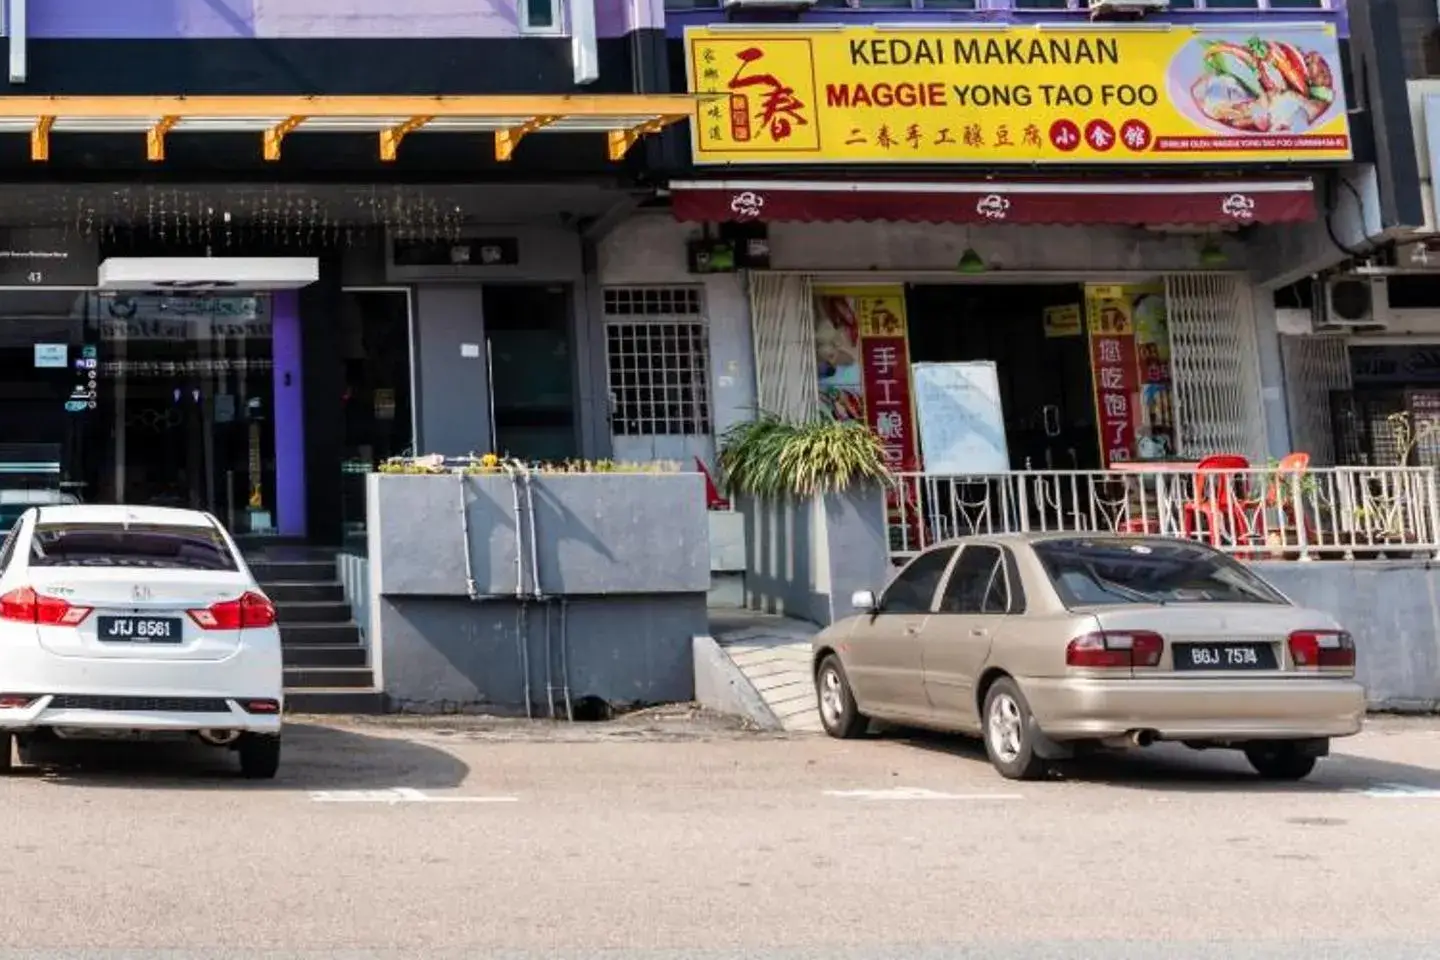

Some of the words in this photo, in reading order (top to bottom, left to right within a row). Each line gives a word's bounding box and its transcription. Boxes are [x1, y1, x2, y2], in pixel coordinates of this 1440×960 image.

[849, 39, 944, 65] KEDAI
[954, 38, 1119, 65] MAKANAN
[826, 83, 947, 107] MAGGIE
[953, 85, 1032, 107] YONG
[1039, 85, 1094, 106] TAO
[1102, 84, 1158, 106] FOO
